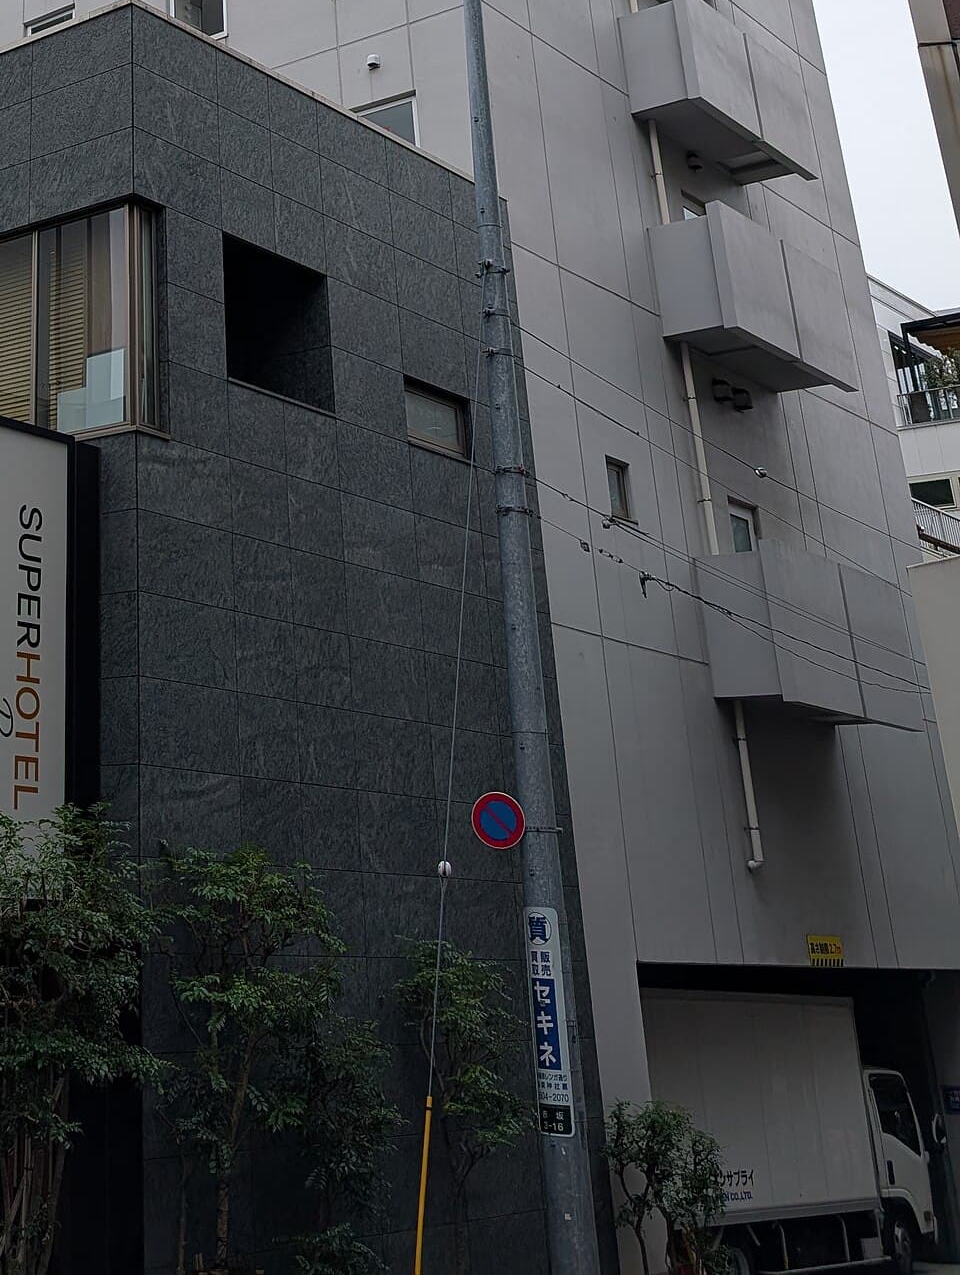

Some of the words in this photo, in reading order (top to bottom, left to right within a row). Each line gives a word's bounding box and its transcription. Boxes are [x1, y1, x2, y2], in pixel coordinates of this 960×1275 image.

[528, 916, 549, 942] 質
[534, 980, 557, 1067] セキネ
